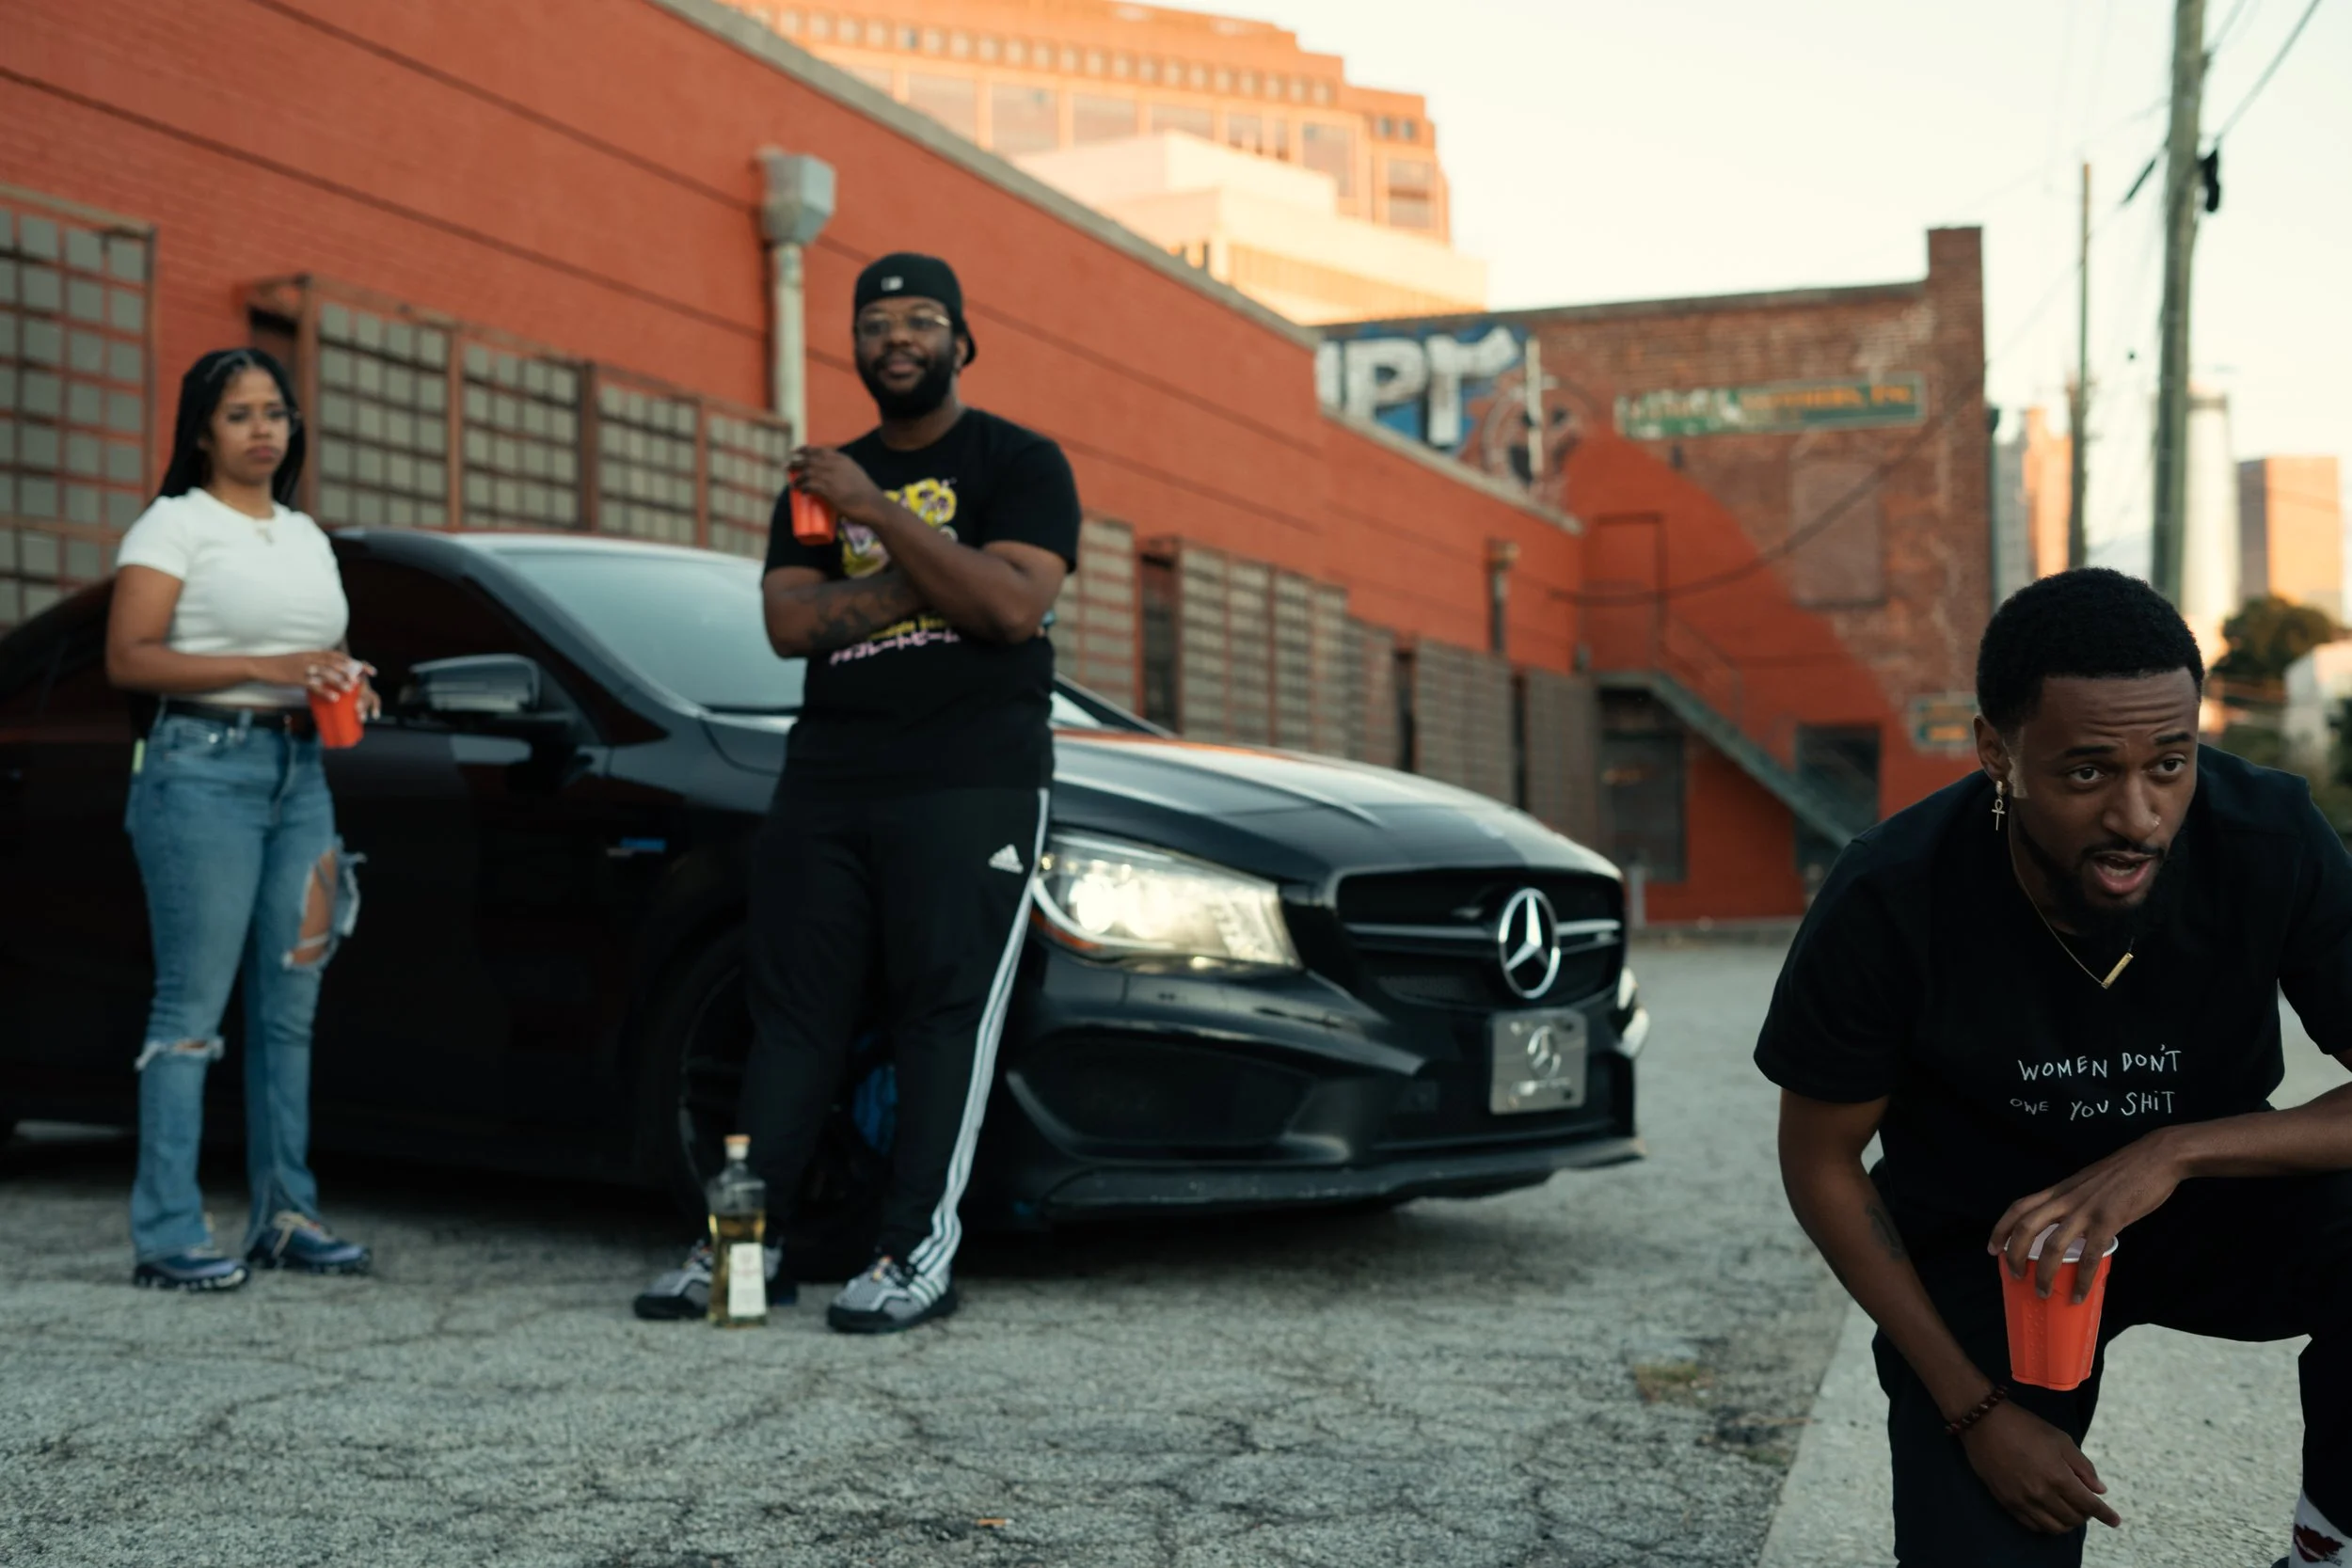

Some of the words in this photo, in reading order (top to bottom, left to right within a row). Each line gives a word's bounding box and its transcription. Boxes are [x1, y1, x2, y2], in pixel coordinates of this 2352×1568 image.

[2017, 1054, 2108, 1083] WOMEN
[2122, 1043, 2183, 1073] DON'T
[2010, 1097, 2050, 1117] OWE
[2070, 1099, 2110, 1122] YOU
